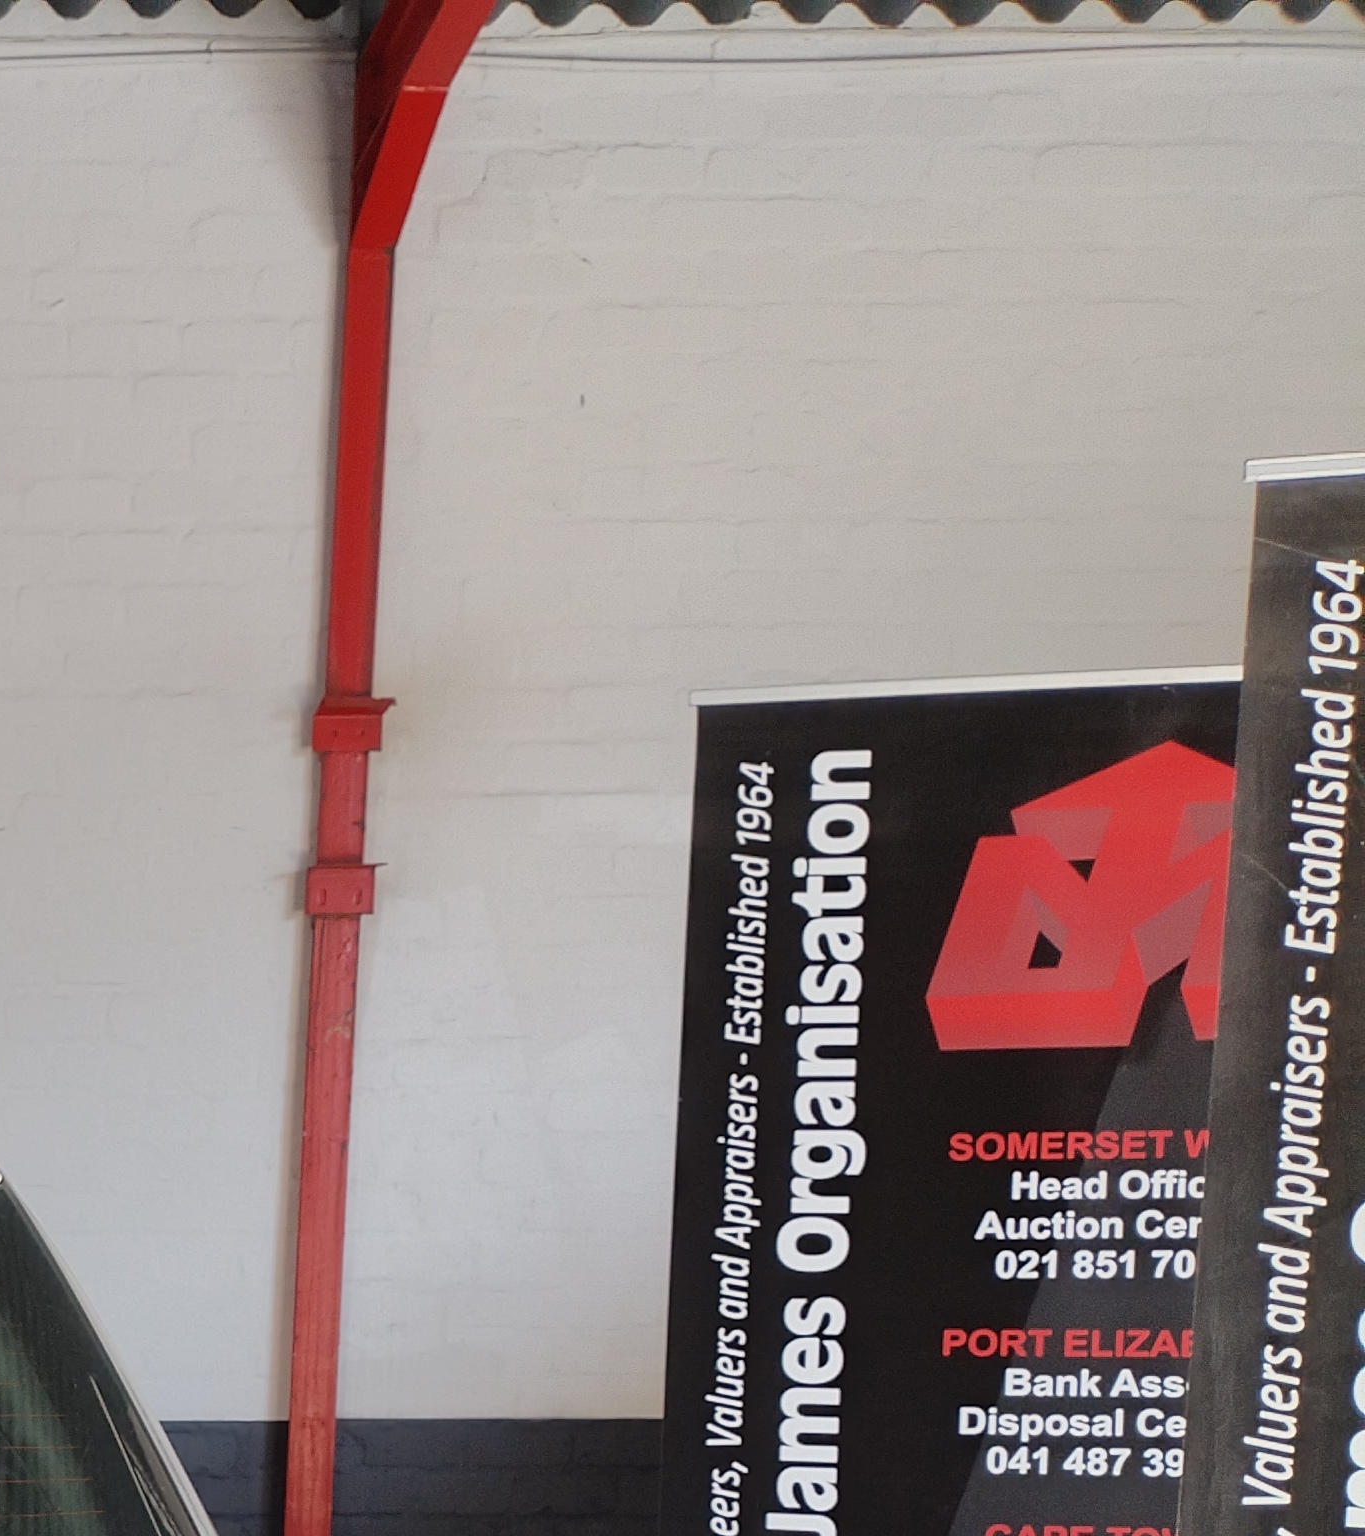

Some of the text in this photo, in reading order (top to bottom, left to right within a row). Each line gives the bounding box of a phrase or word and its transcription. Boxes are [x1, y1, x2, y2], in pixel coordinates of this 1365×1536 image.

[1309, 559, 1365, 675] 1964
[736, 760, 775, 844] 1964
[1284, 689, 1355, 955] Established
[723, 850, 769, 1045] Established
[776, 749, 873, 1273] Organisation
[948, 1129, 1173, 1162] SOMERSET
[1264, 994, 1330, 1238] Appraisers
[714, 1073, 760, 1249] Appraisers
[1011, 1169, 1205, 1201] Head Offic
[974, 1210, 1124, 1240] Auction
[995, 1250, 1196, 1280] 021 851 70
[710, 1254, 750, 1319] and
[1258, 1242, 1311, 1334] and
[941, 1328, 1053, 1358] PORT
[1004, 1367, 1190, 1399] Bank Ass
[705, 1325, 749, 1448] Valuers
[958, 1406, 1125, 1443] Disposal
[1242, 1344, 1303, 1505] Valuers
[986, 1446, 1185, 1478] 041 487 39
